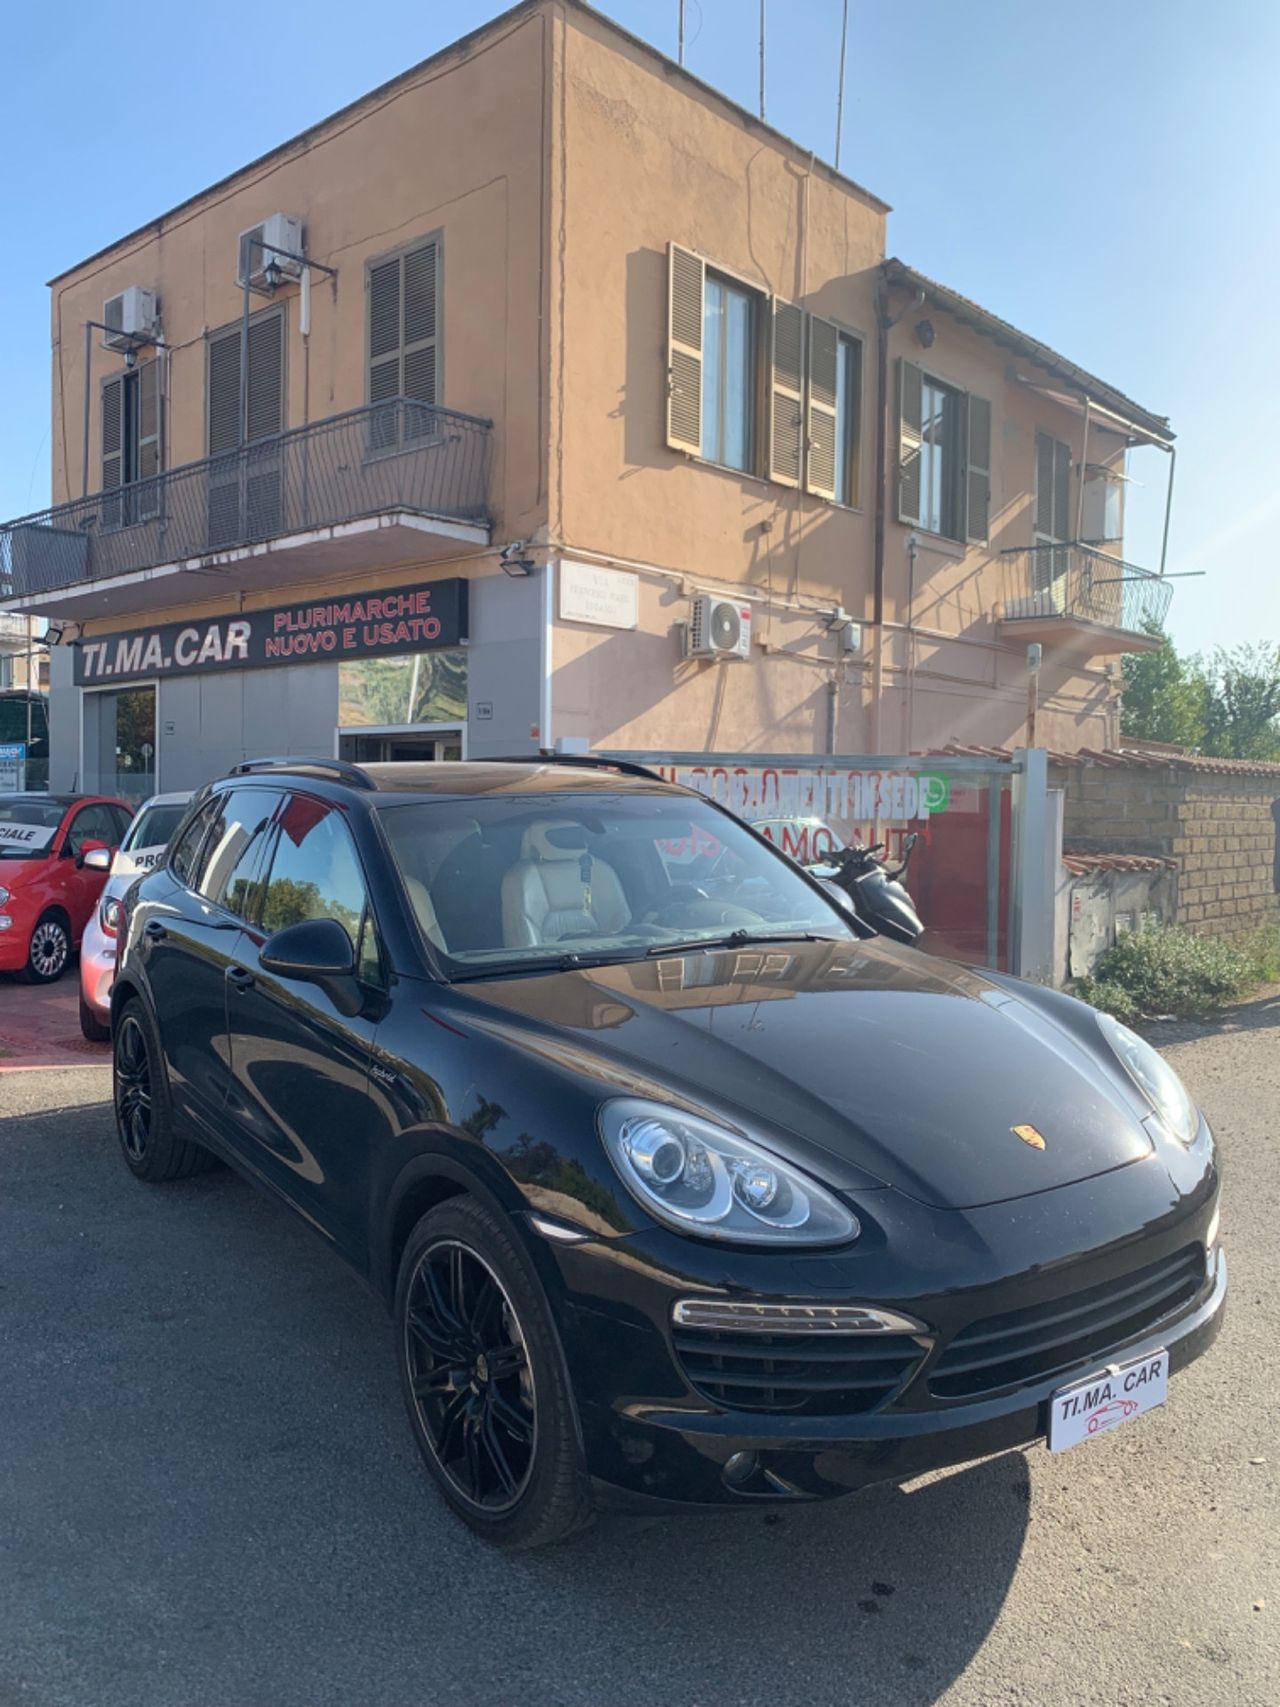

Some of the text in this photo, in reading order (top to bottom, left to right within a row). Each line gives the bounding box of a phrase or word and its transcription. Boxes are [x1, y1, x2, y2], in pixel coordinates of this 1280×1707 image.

[273, 590, 431, 633] PLURIMARCHE
[82, 620, 251, 677] TI.MA.CAR
[264, 617, 441, 657] NUOVO E USATO
[1123, 1361, 1162, 1392] CAR
